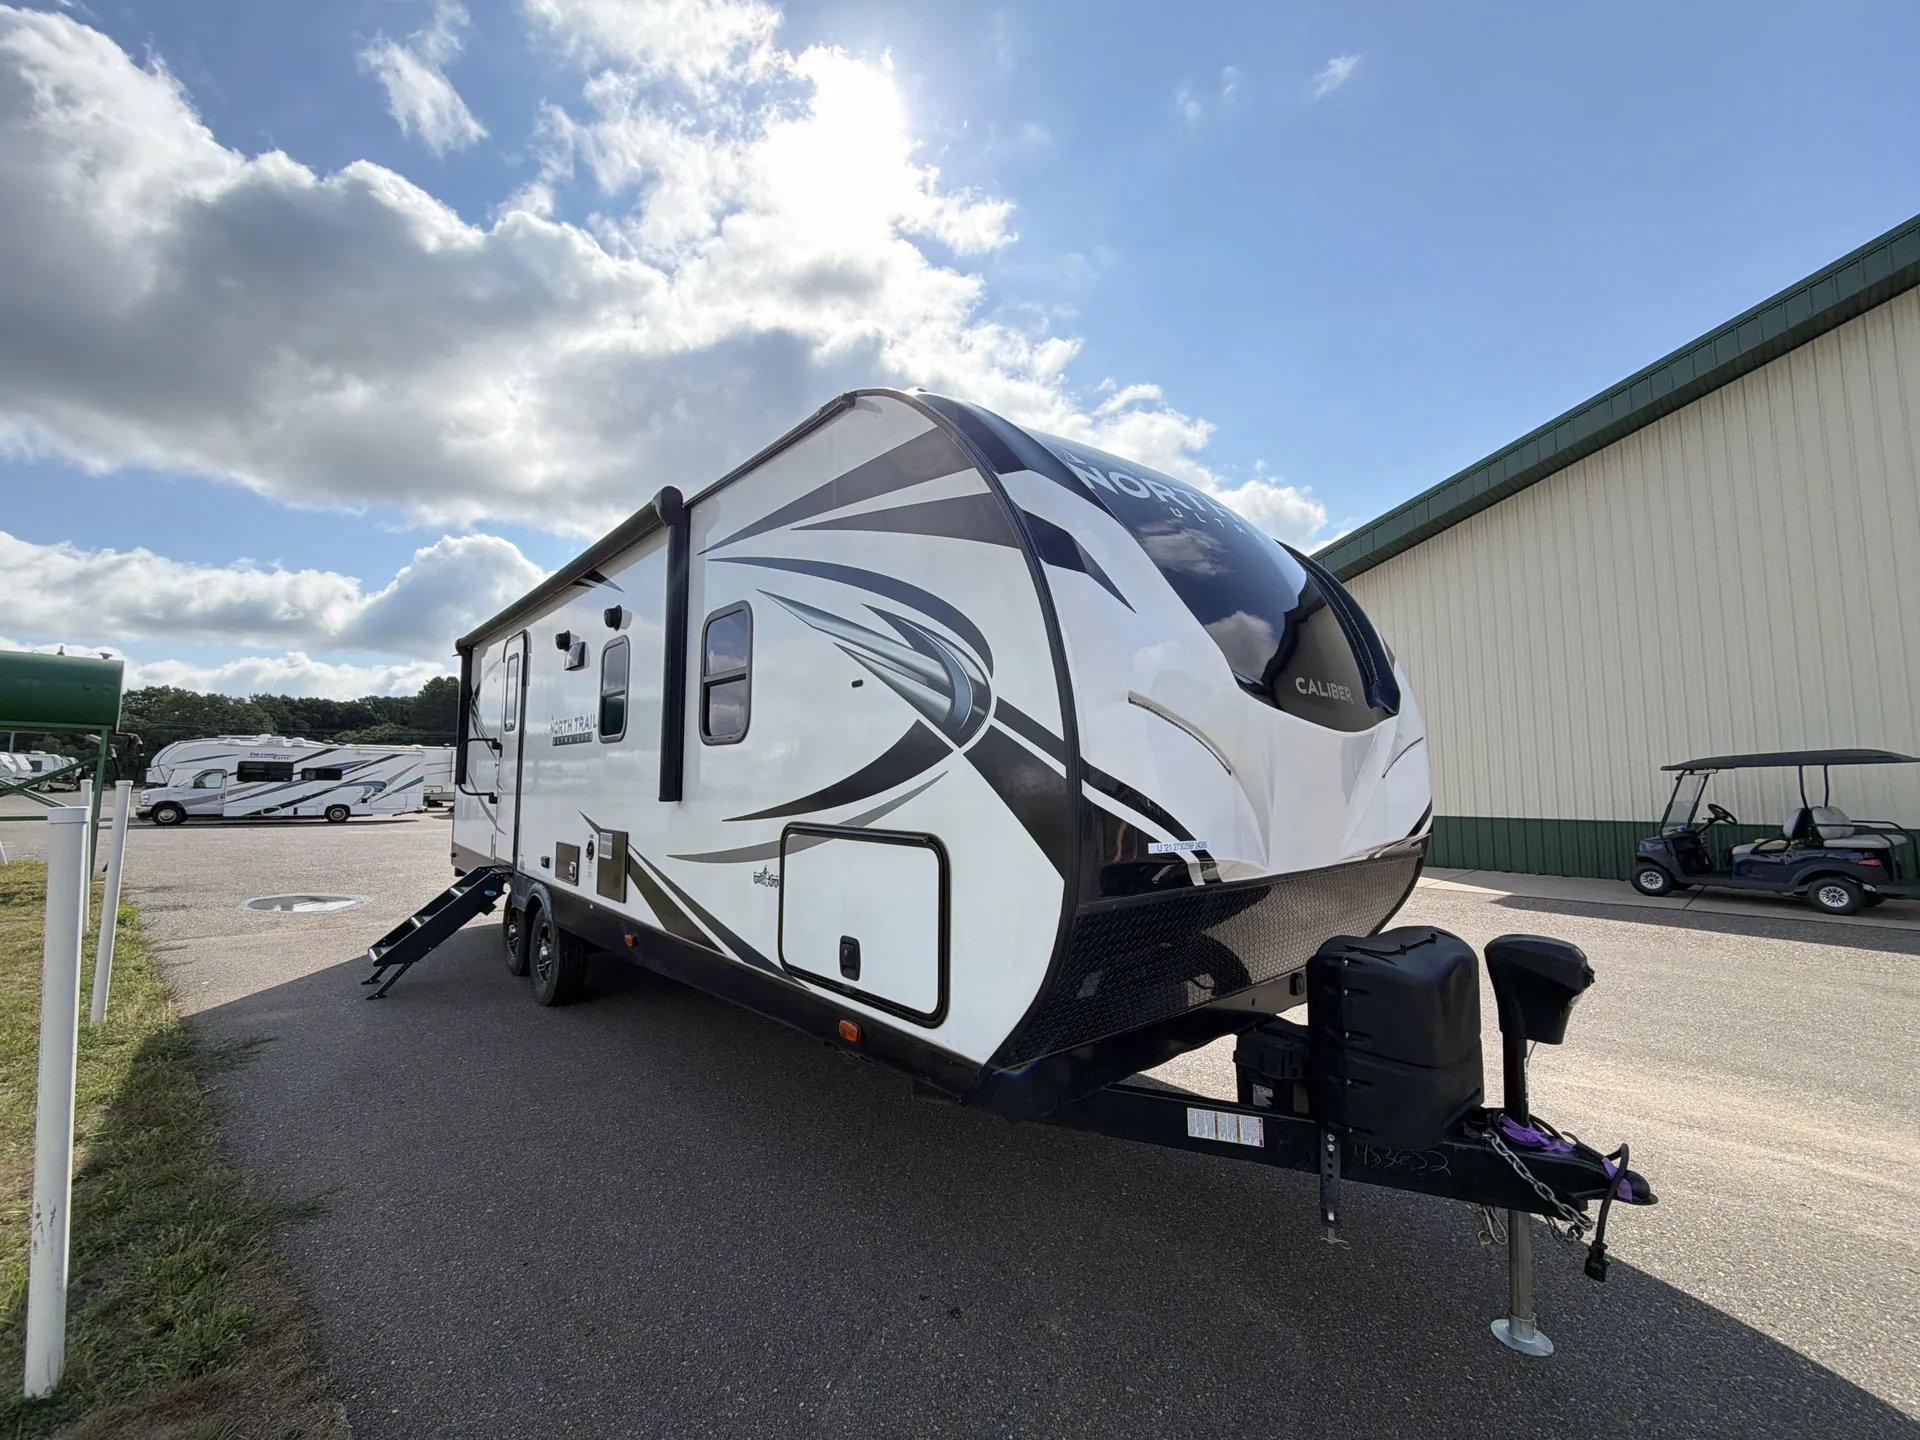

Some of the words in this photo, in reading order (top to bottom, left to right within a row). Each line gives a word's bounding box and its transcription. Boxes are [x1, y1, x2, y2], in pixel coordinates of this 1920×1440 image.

[1068, 462, 1243, 525] NORTH
[1295, 676, 1355, 705] CALIBER
[550, 717, 573, 735] NORTH
[574, 713, 597, 732] TRAIL
[553, 736, 572, 746] ULTRA
[576, 733, 593, 743] LITE
[1157, 844, 1163, 852] U
